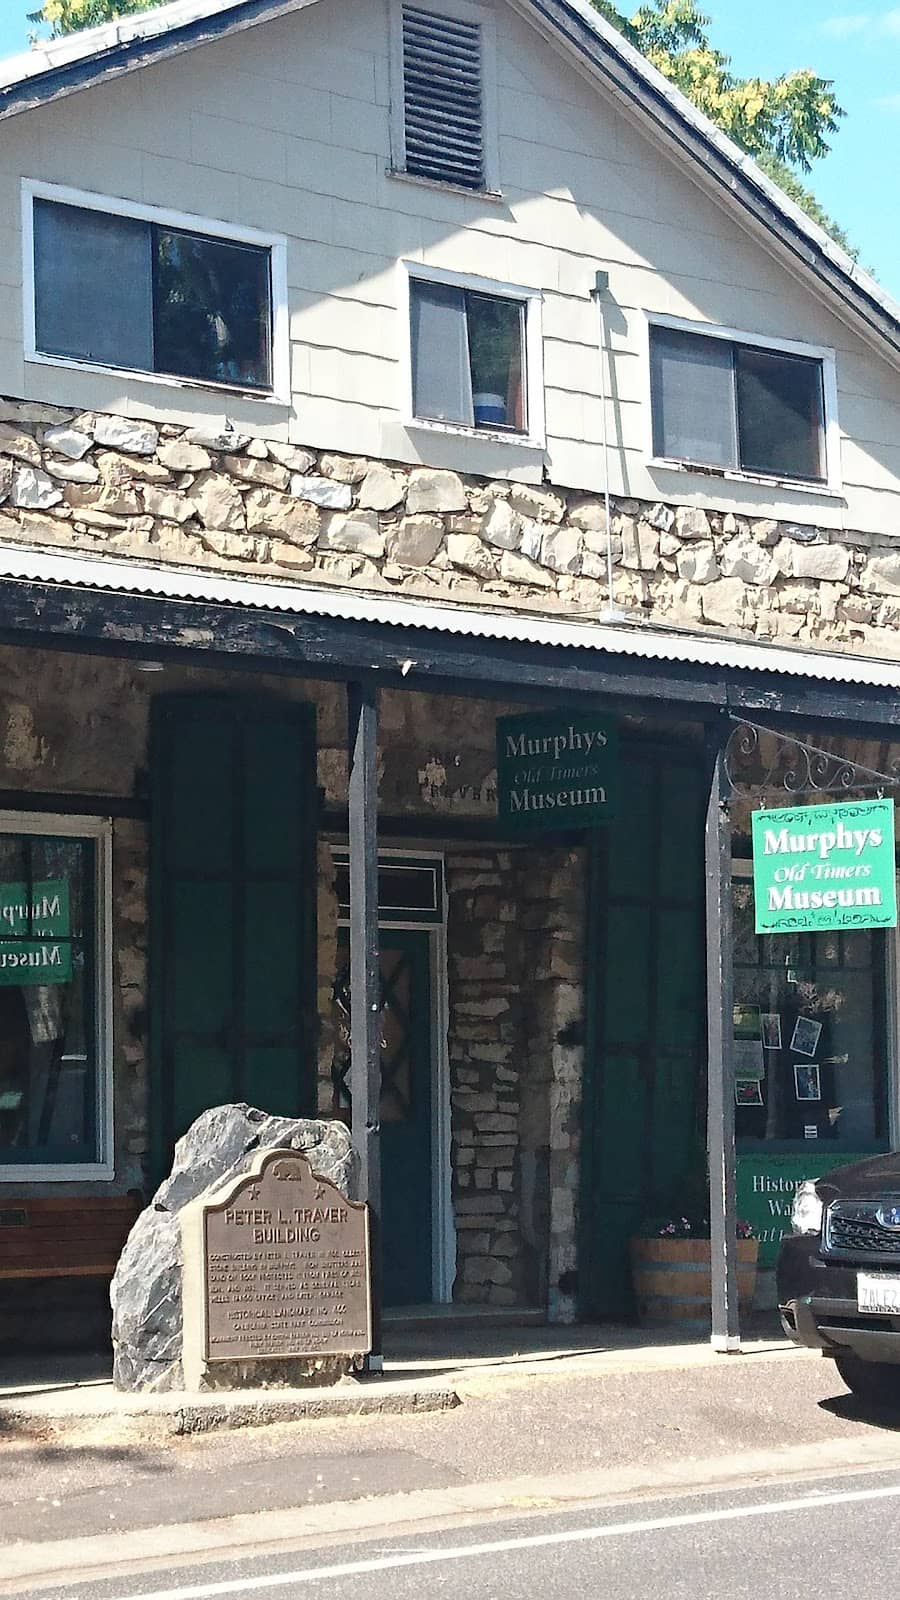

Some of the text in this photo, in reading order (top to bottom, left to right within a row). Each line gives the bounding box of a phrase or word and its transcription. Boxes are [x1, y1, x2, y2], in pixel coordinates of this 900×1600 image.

[505, 726, 608, 759] Murphys
[509, 786, 608, 813] Museum
[762, 822, 884, 859] Murphys
[773, 861, 872, 883] Old Timers
[767, 885, 882, 911] Museum
[224, 1207, 348, 1225] PETER L. TRAVER
[253, 1226, 320, 1244] BUILDING
